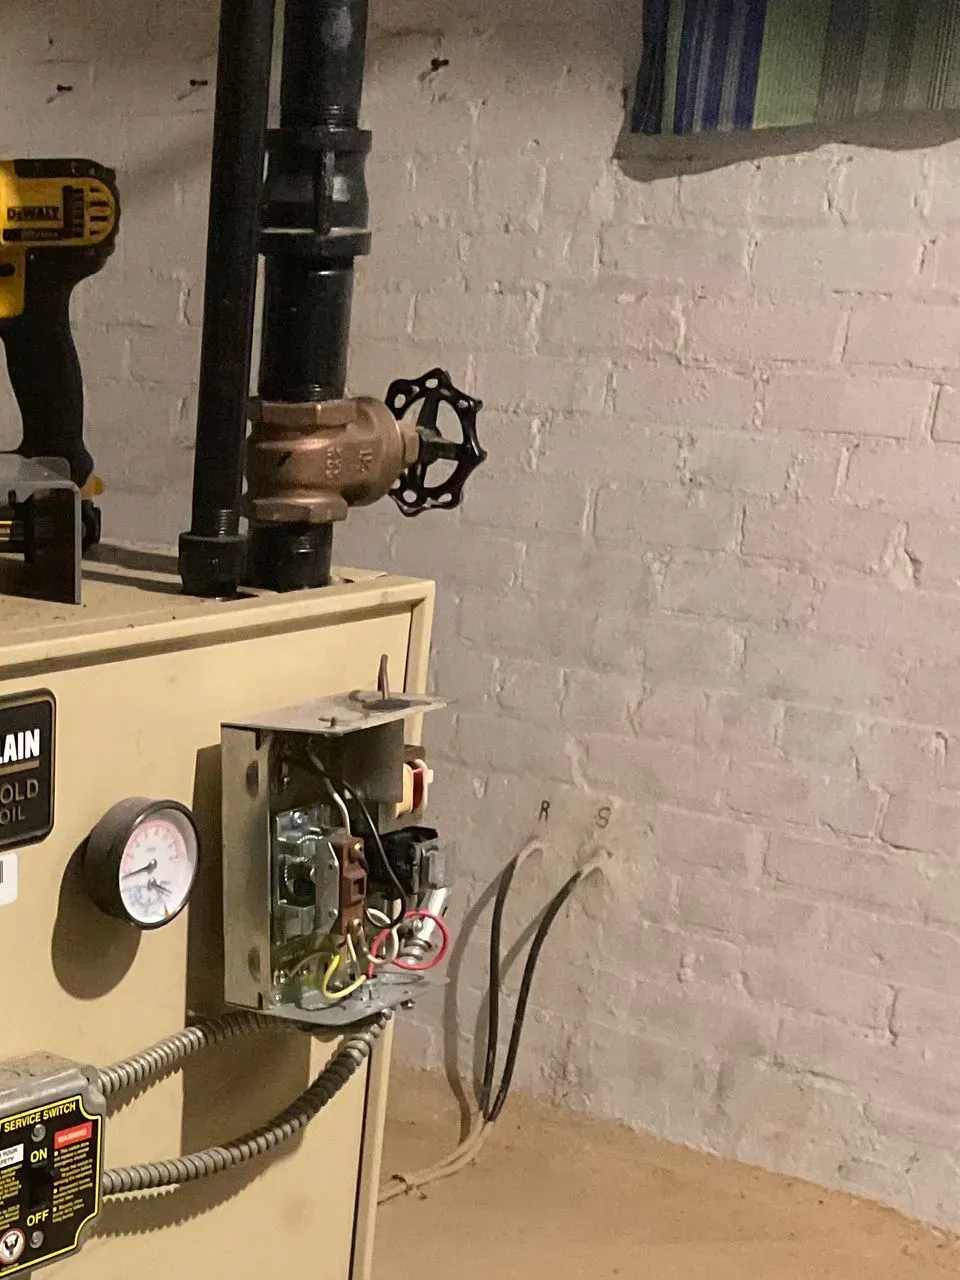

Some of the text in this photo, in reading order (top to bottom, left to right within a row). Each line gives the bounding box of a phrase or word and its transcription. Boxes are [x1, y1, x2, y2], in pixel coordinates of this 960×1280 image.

[538, 799, 550, 821] R
[595, 806, 611, 829] S
[3, 1101, 77, 1133] SERVICE SWITCH
[2, 1148, 19, 1158] YOUR
[30, 1147, 48, 1163] ON
[26, 1208, 49, 1227] OFF
